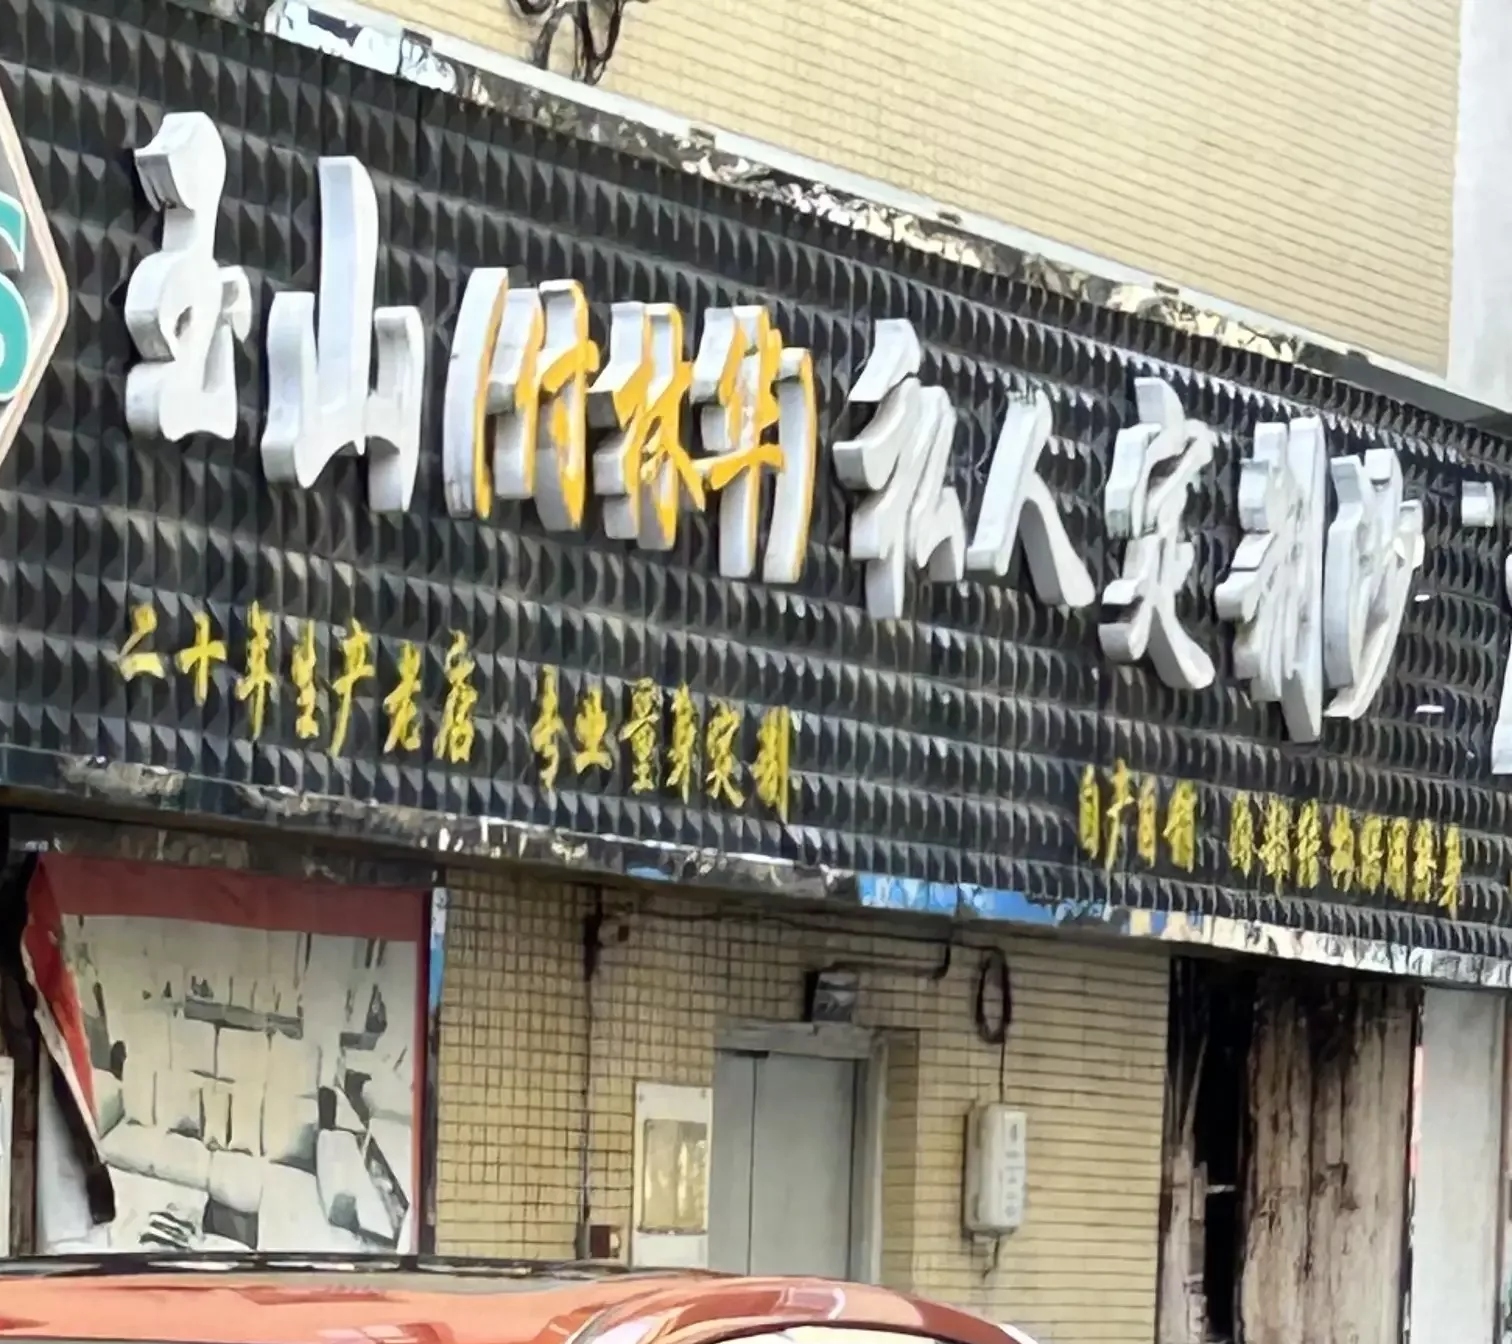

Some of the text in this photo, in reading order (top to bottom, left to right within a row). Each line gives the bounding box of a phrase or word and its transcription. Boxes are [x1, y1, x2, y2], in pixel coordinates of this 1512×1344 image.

[118, 601, 476, 764] 二十年生产老店
